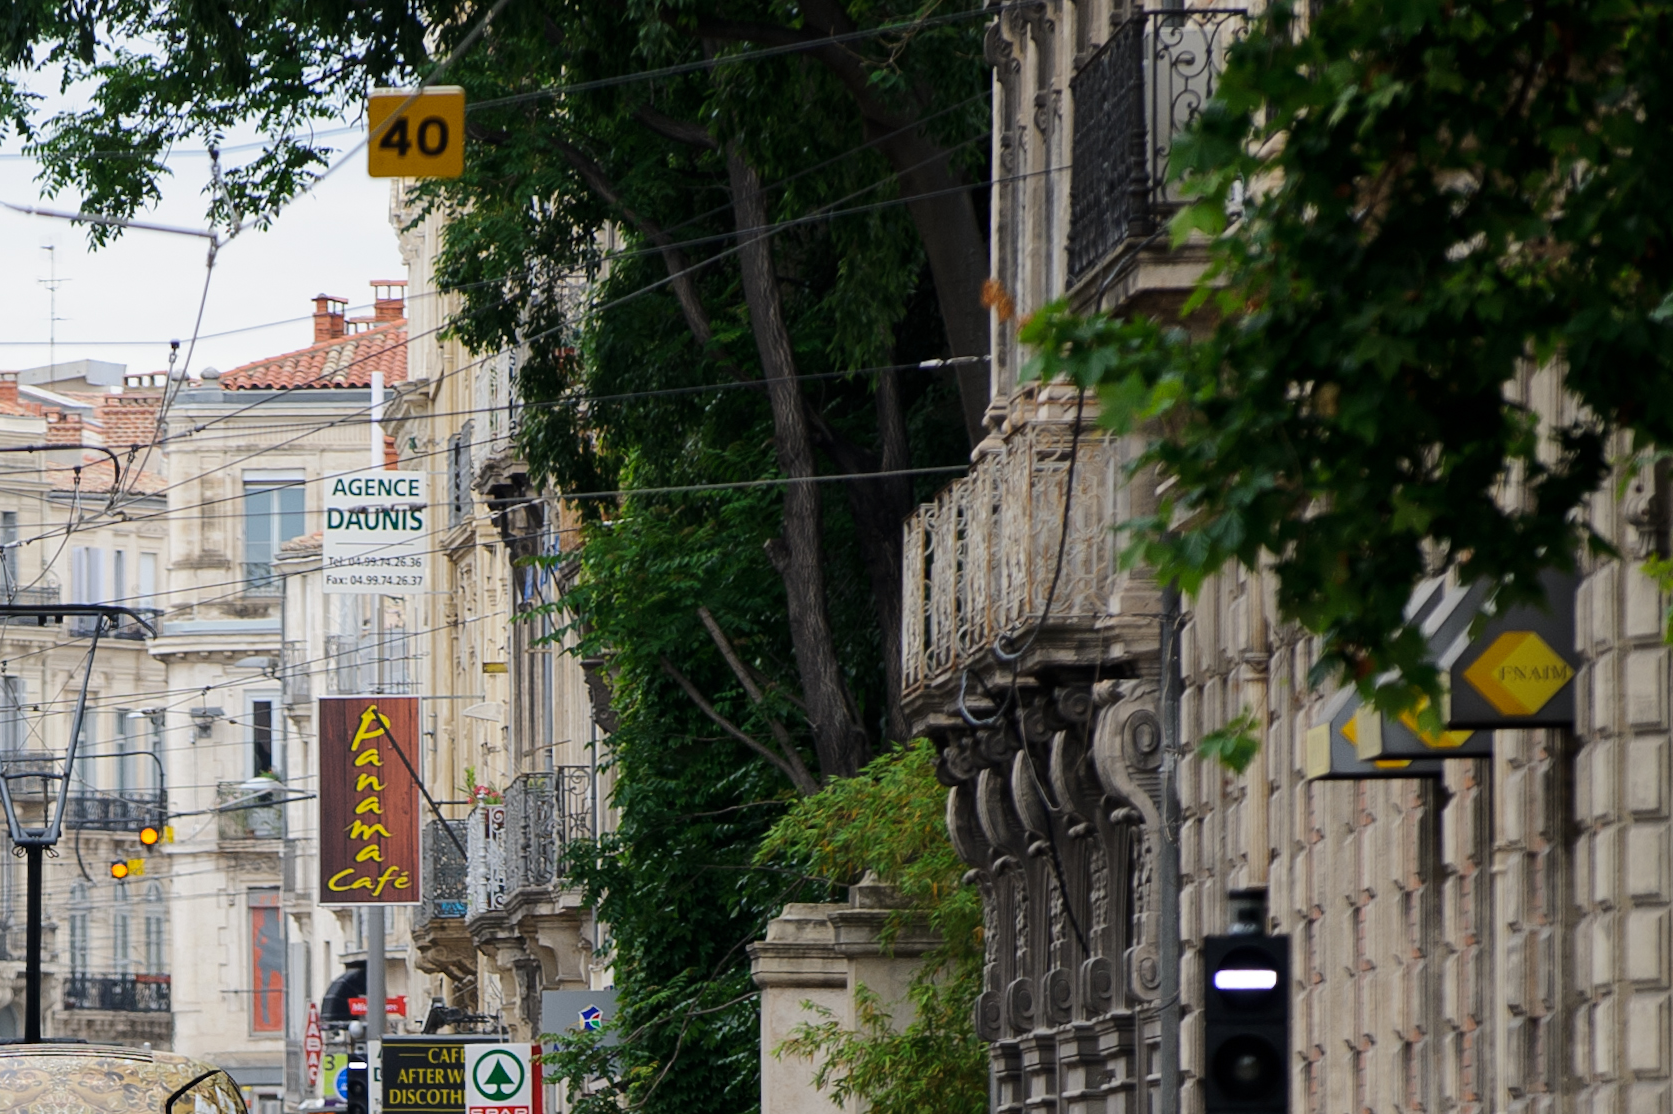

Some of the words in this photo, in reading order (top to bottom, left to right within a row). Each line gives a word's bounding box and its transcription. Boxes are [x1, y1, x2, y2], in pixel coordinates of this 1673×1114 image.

[379, 115, 449, 156] 40
[332, 478, 420, 496] AGENCE
[327, 507, 423, 531] DAUNIS
[326, 574, 348, 585] Fax:
[350, 575, 423, 586] 04.99.74.26.37
[1498, 664, 1567, 681] FNAIM
[343, 704, 394, 862] Panama
[327, 865, 412, 897] Café
[306, 1008, 321, 1080] TABAC
[397, 1068, 445, 1084] AFTER
[447, 1068, 465, 1084] W
[389, 1088, 465, 1105] DISCOTH
